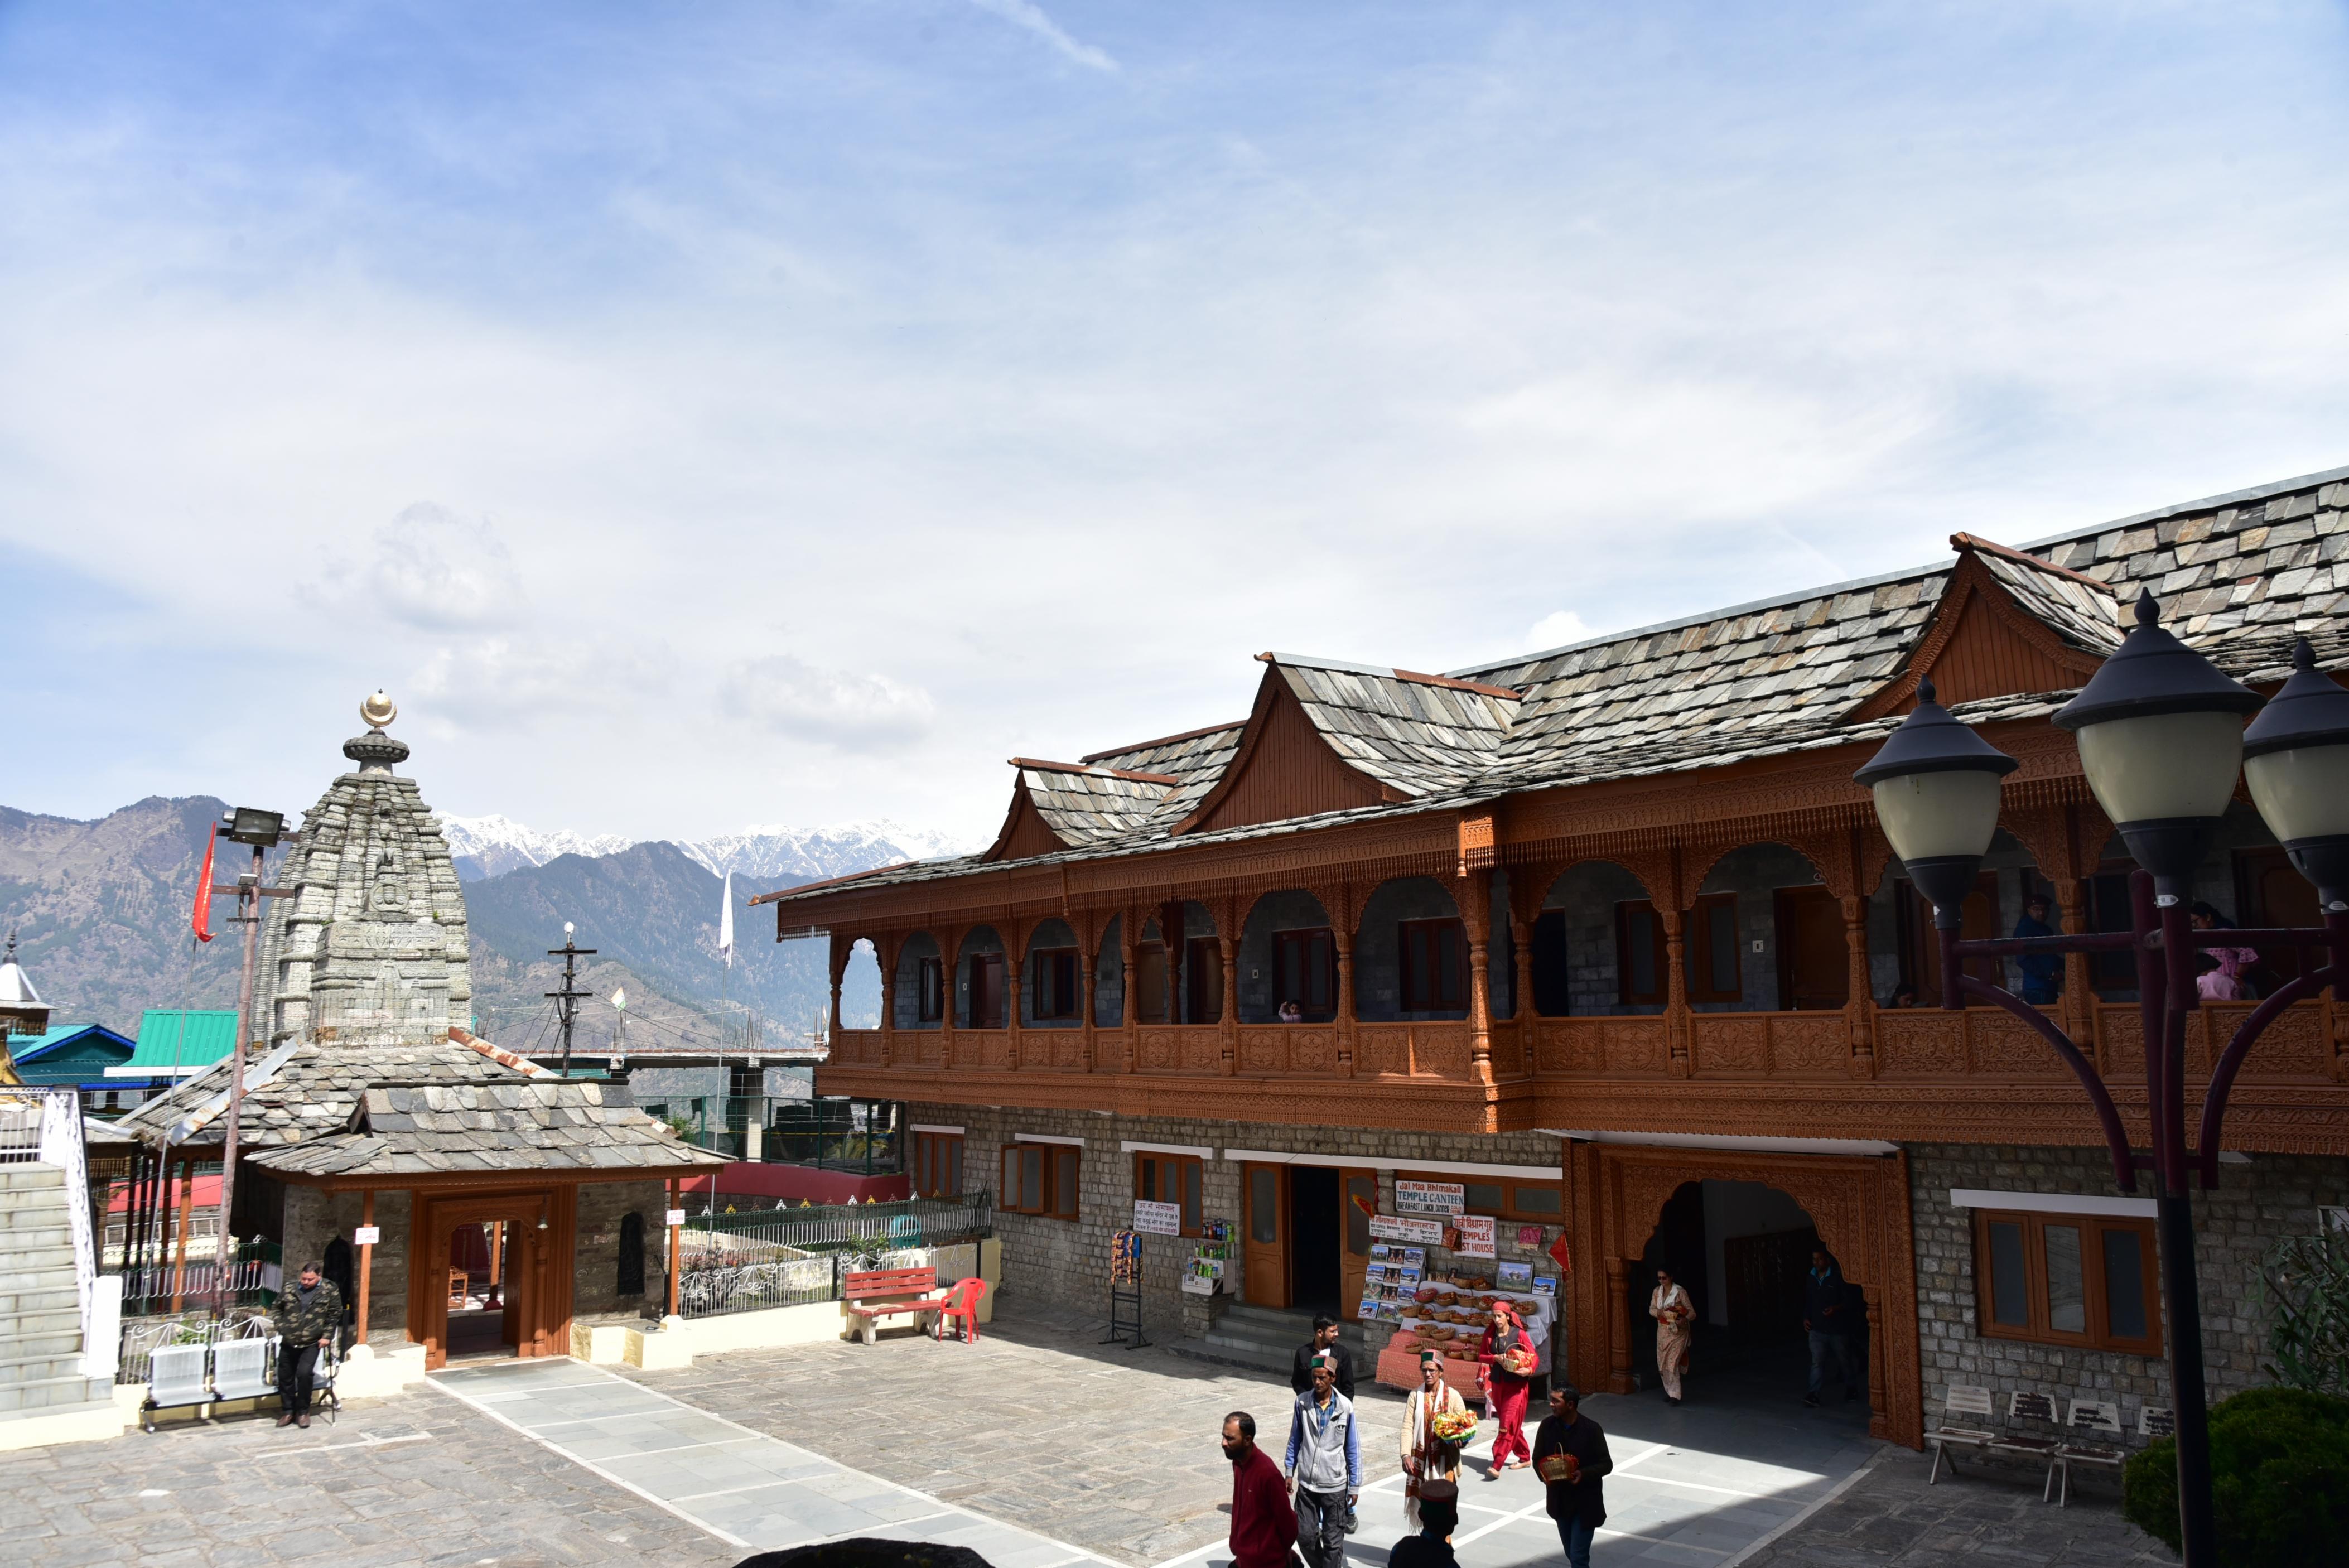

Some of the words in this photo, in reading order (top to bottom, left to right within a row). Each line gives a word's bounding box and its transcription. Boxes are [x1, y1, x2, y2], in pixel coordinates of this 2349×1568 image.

[1412, 1183, 1425, 1191] Maa
[1397, 1191, 1427, 1202] TEMPLE
[1429, 1193, 1464, 1205] CANTEEN
[1466, 1217, 1483, 1229] विश्राम
[1463, 1231, 1490, 1241] EMPLES
[1472, 1243, 1494, 1253] HOUSE
